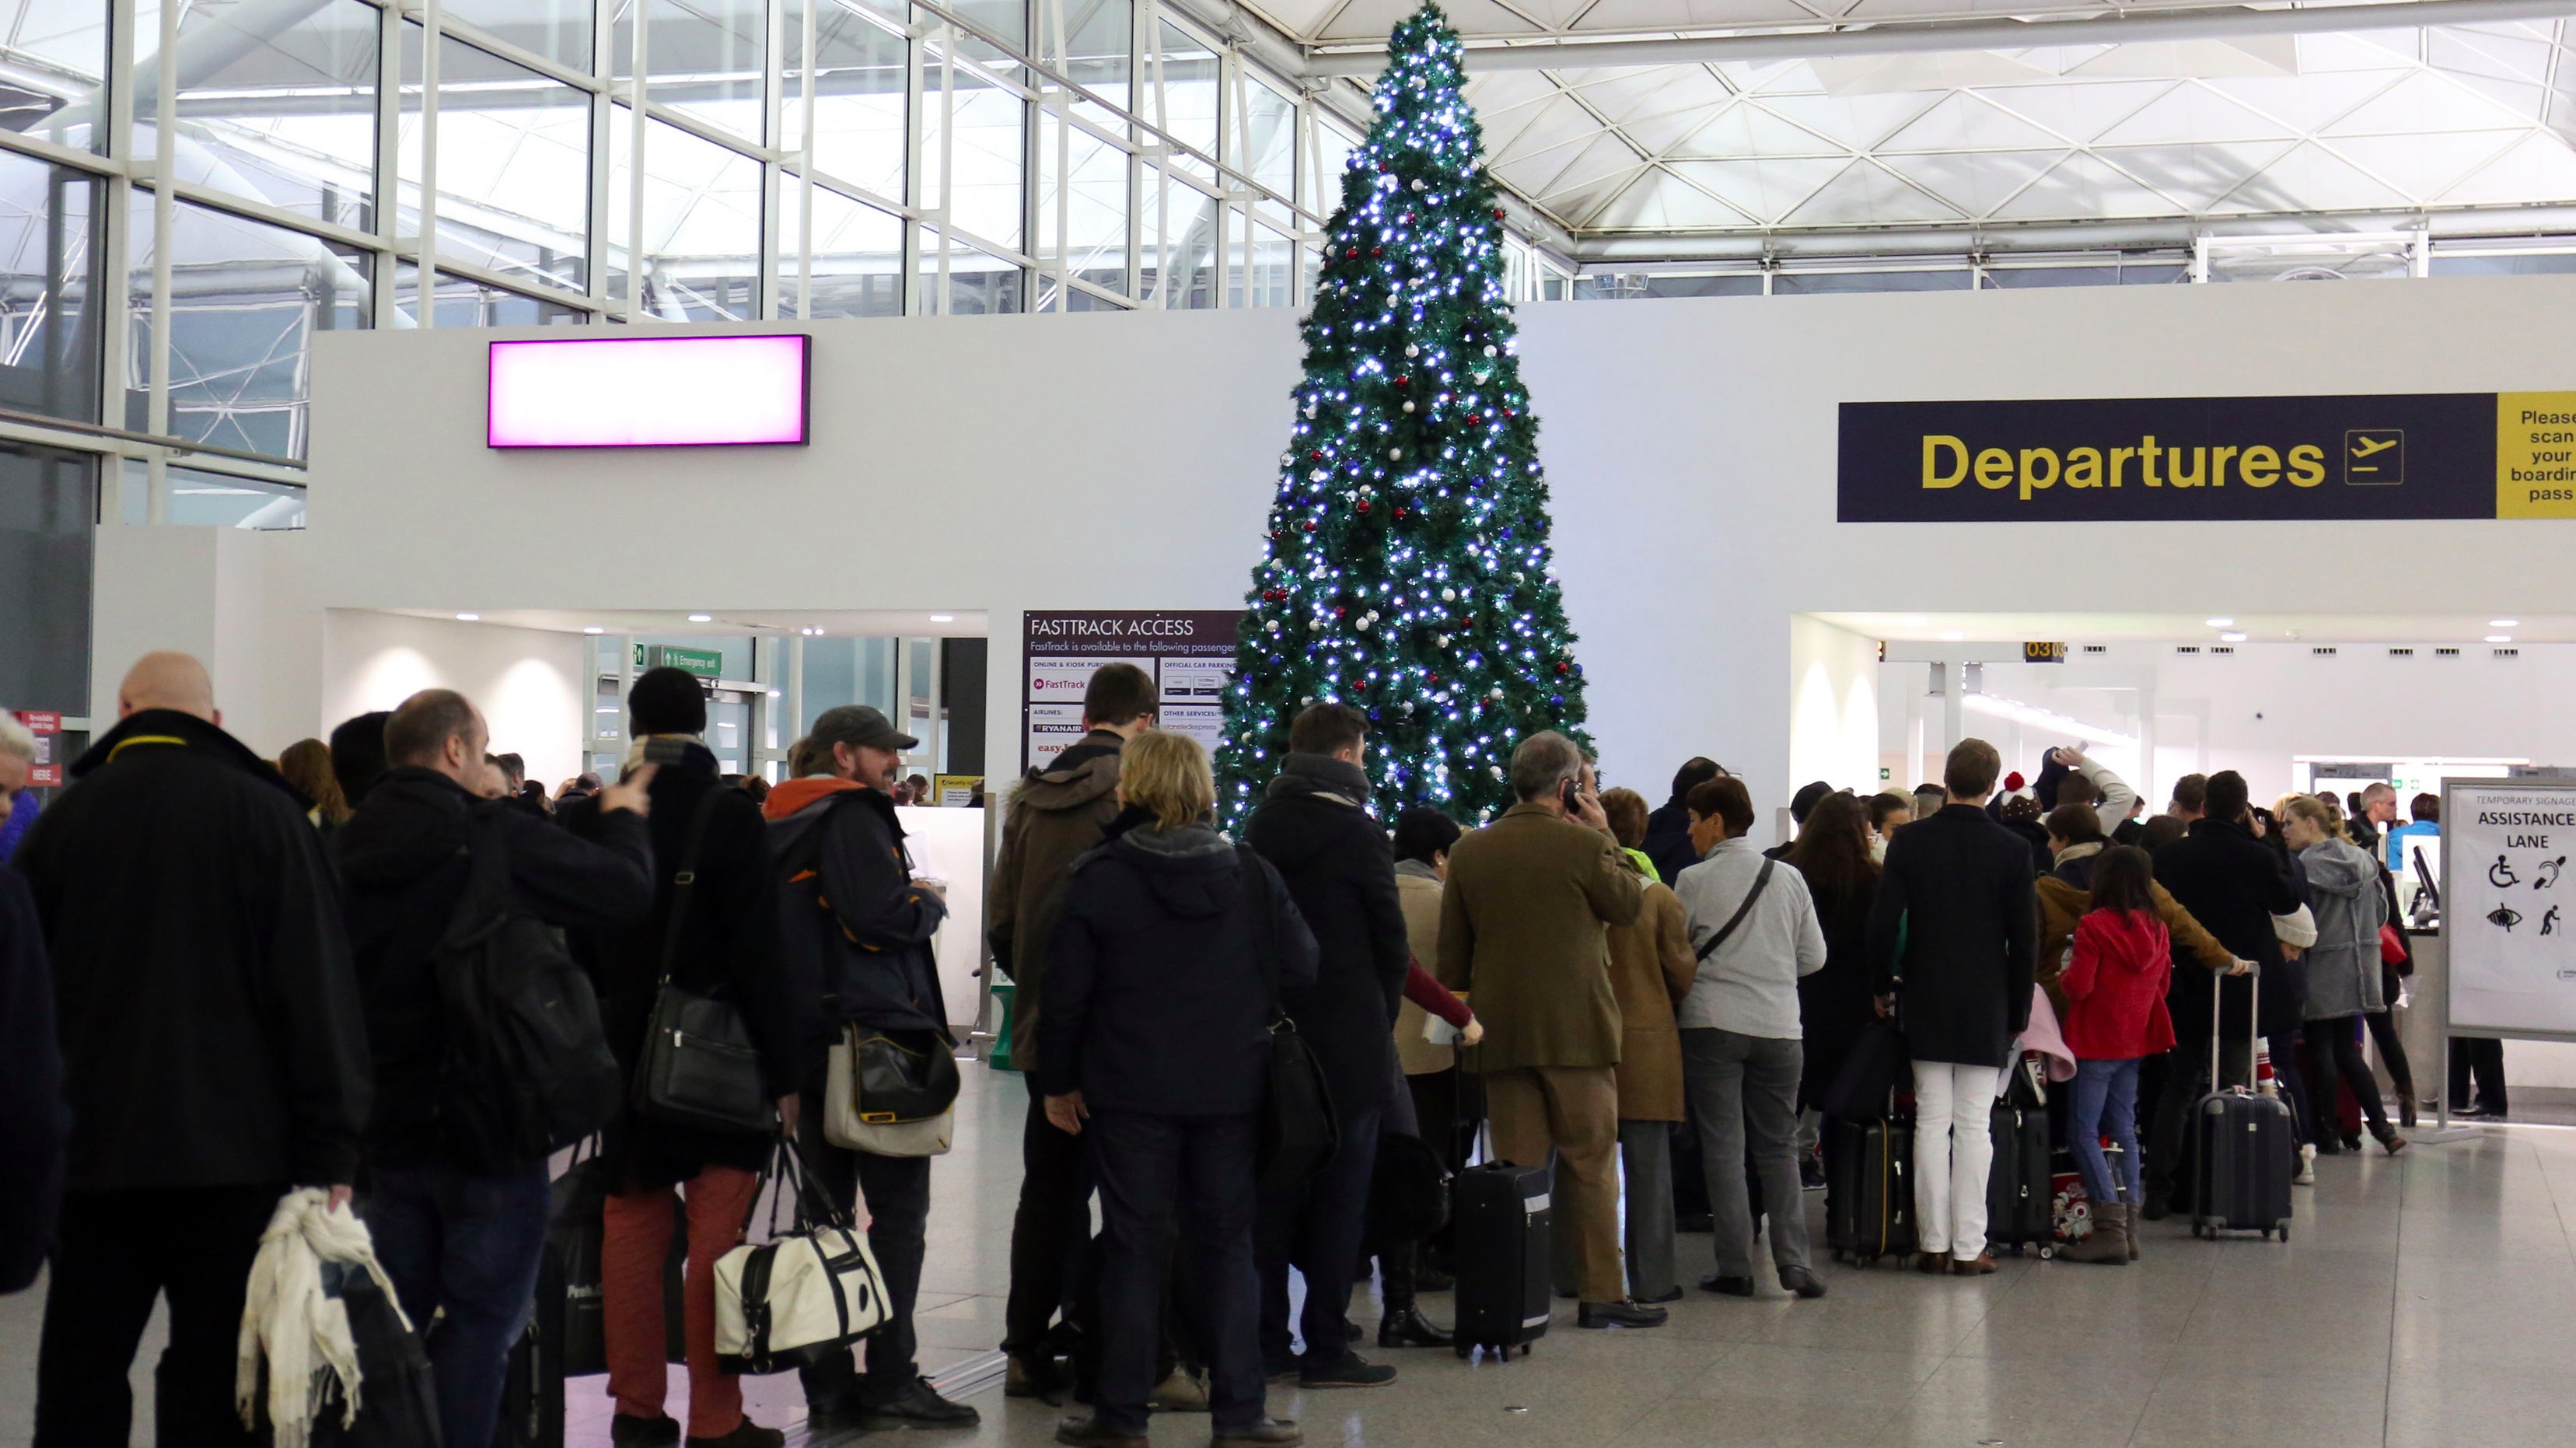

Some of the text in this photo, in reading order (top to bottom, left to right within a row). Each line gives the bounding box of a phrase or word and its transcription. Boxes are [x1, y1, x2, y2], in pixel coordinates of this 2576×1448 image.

[2530, 432, 2574, 443] scan
[2532, 451, 2572, 465] your
[1922, 435, 2325, 500] Departures
[2511, 467, 2576, 481] boardin
[2529, 489, 2573, 503] pass
[1031, 619, 1194, 636] FASTTRACK ACCESS
[1030, 641, 1237, 654] FastTrack is available to the following passenger
[2027, 642, 2050, 656] 03
[1045, 680, 1085, 689] FastTrack
[2476, 796, 2533, 805] TEMPORARY
[2478, 812, 2576, 826] ASSISTANCE
[2507, 834, 2549, 848] LANE
